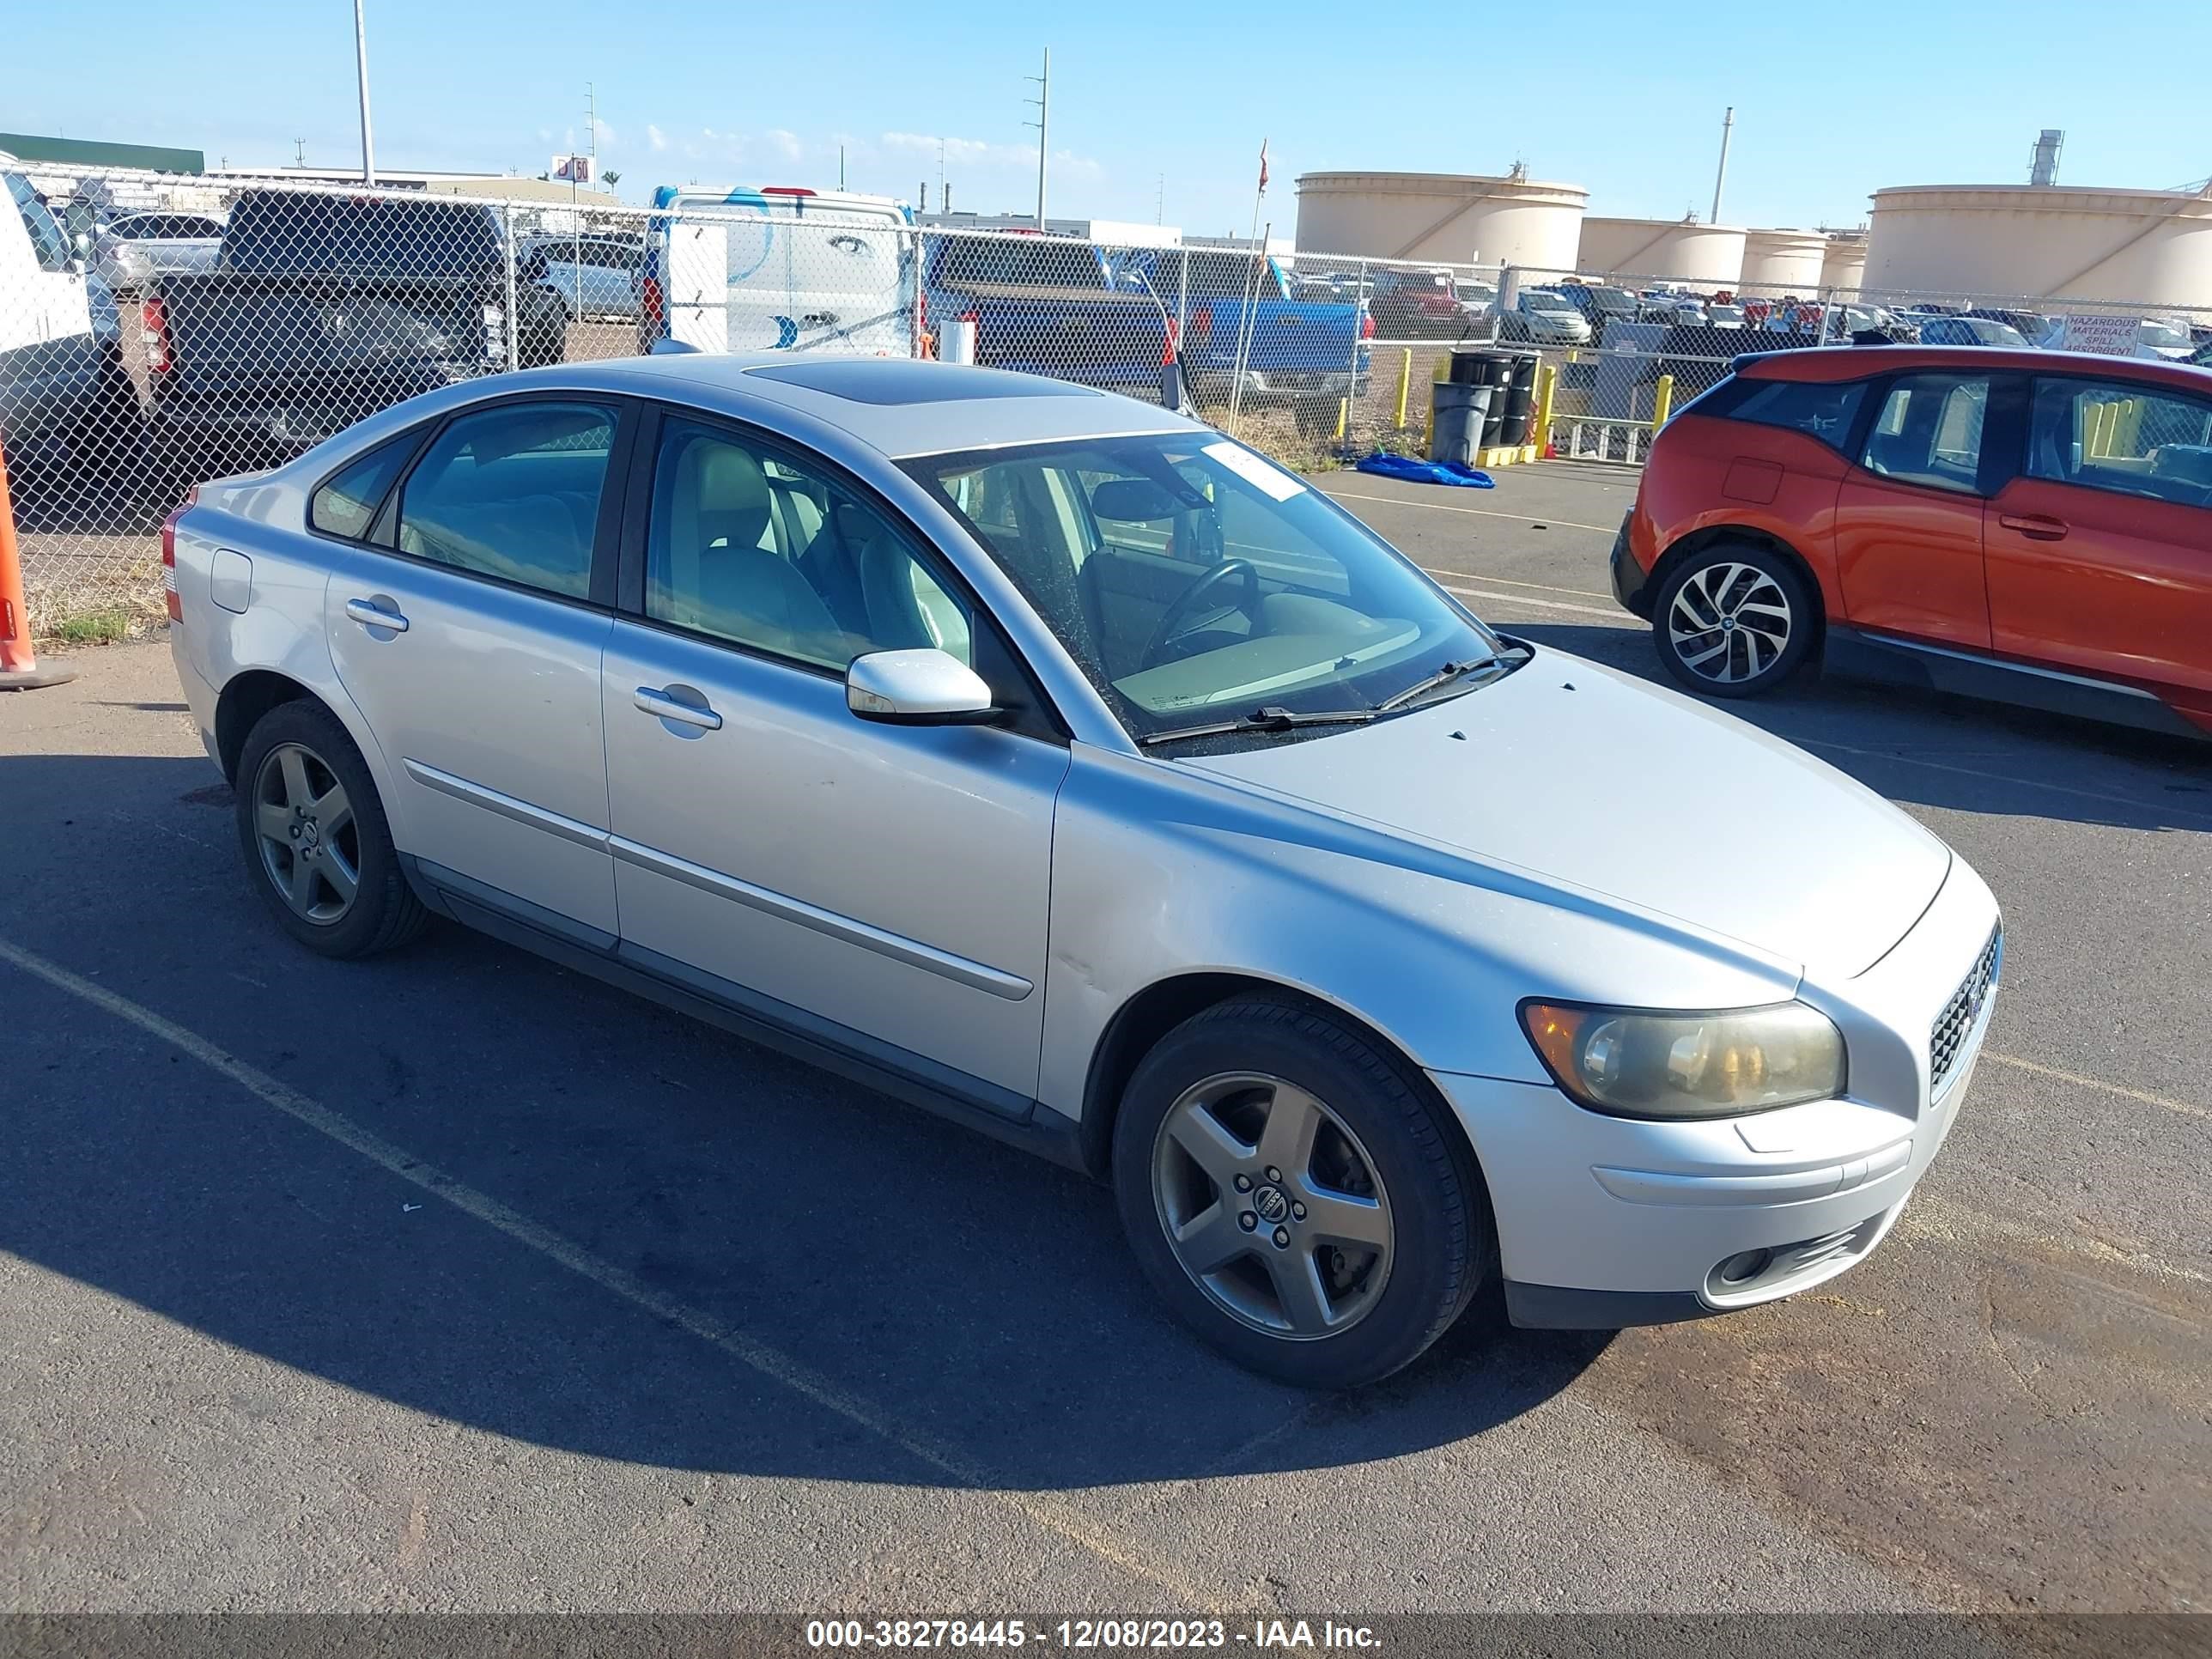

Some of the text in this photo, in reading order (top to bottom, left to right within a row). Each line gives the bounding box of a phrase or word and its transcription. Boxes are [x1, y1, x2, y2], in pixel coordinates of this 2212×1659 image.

[577, 161, 588, 179] 50
[2069, 317, 2138, 327] HAZARDOUS
[2070, 326, 2132, 337] MATERIALS
[2085, 336, 2114, 345] SPILL
[2066, 345, 2131, 356] ABSORBENT
[1261, 1192, 1280, 1215] VOLVO
